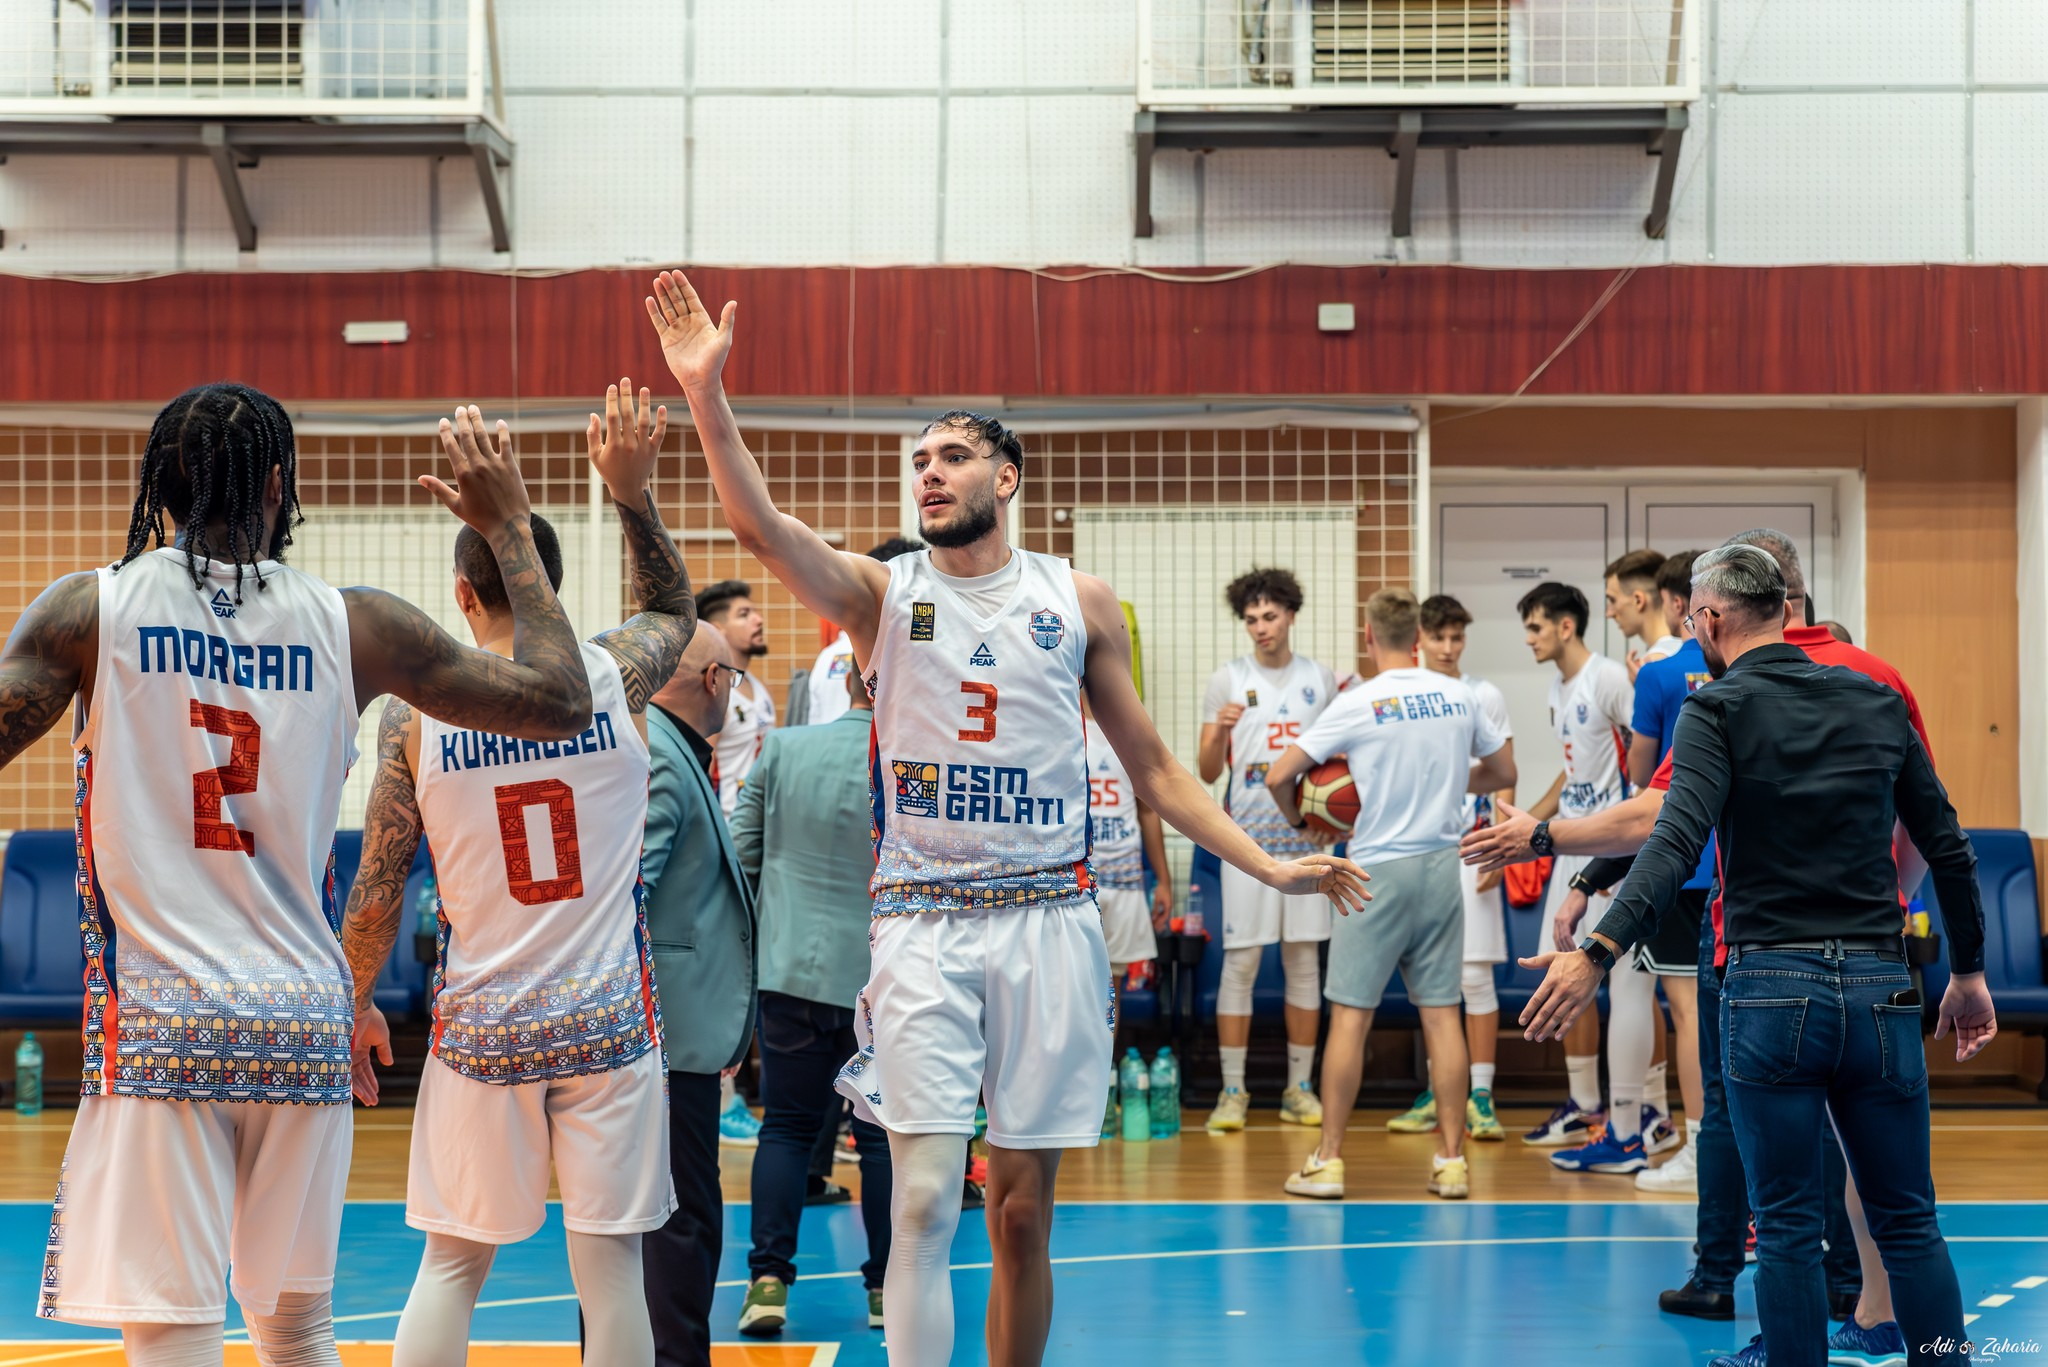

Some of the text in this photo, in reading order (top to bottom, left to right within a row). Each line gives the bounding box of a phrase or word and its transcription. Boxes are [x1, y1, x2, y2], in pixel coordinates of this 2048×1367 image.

[211, 605, 236, 619] EAK
[914, 605, 933, 616] LNBM
[137, 626, 313, 692] MORGAN
[970, 658, 996, 666] PEAK
[958, 681, 998, 742] 3
[1403, 692, 1446, 707] CSM
[1407, 703, 1467, 720] GALATI
[190, 698, 261, 857] 2
[947, 763, 1028, 795] CSM
[945, 793, 1065, 826] GALATI
[494, 778, 583, 906] 0
